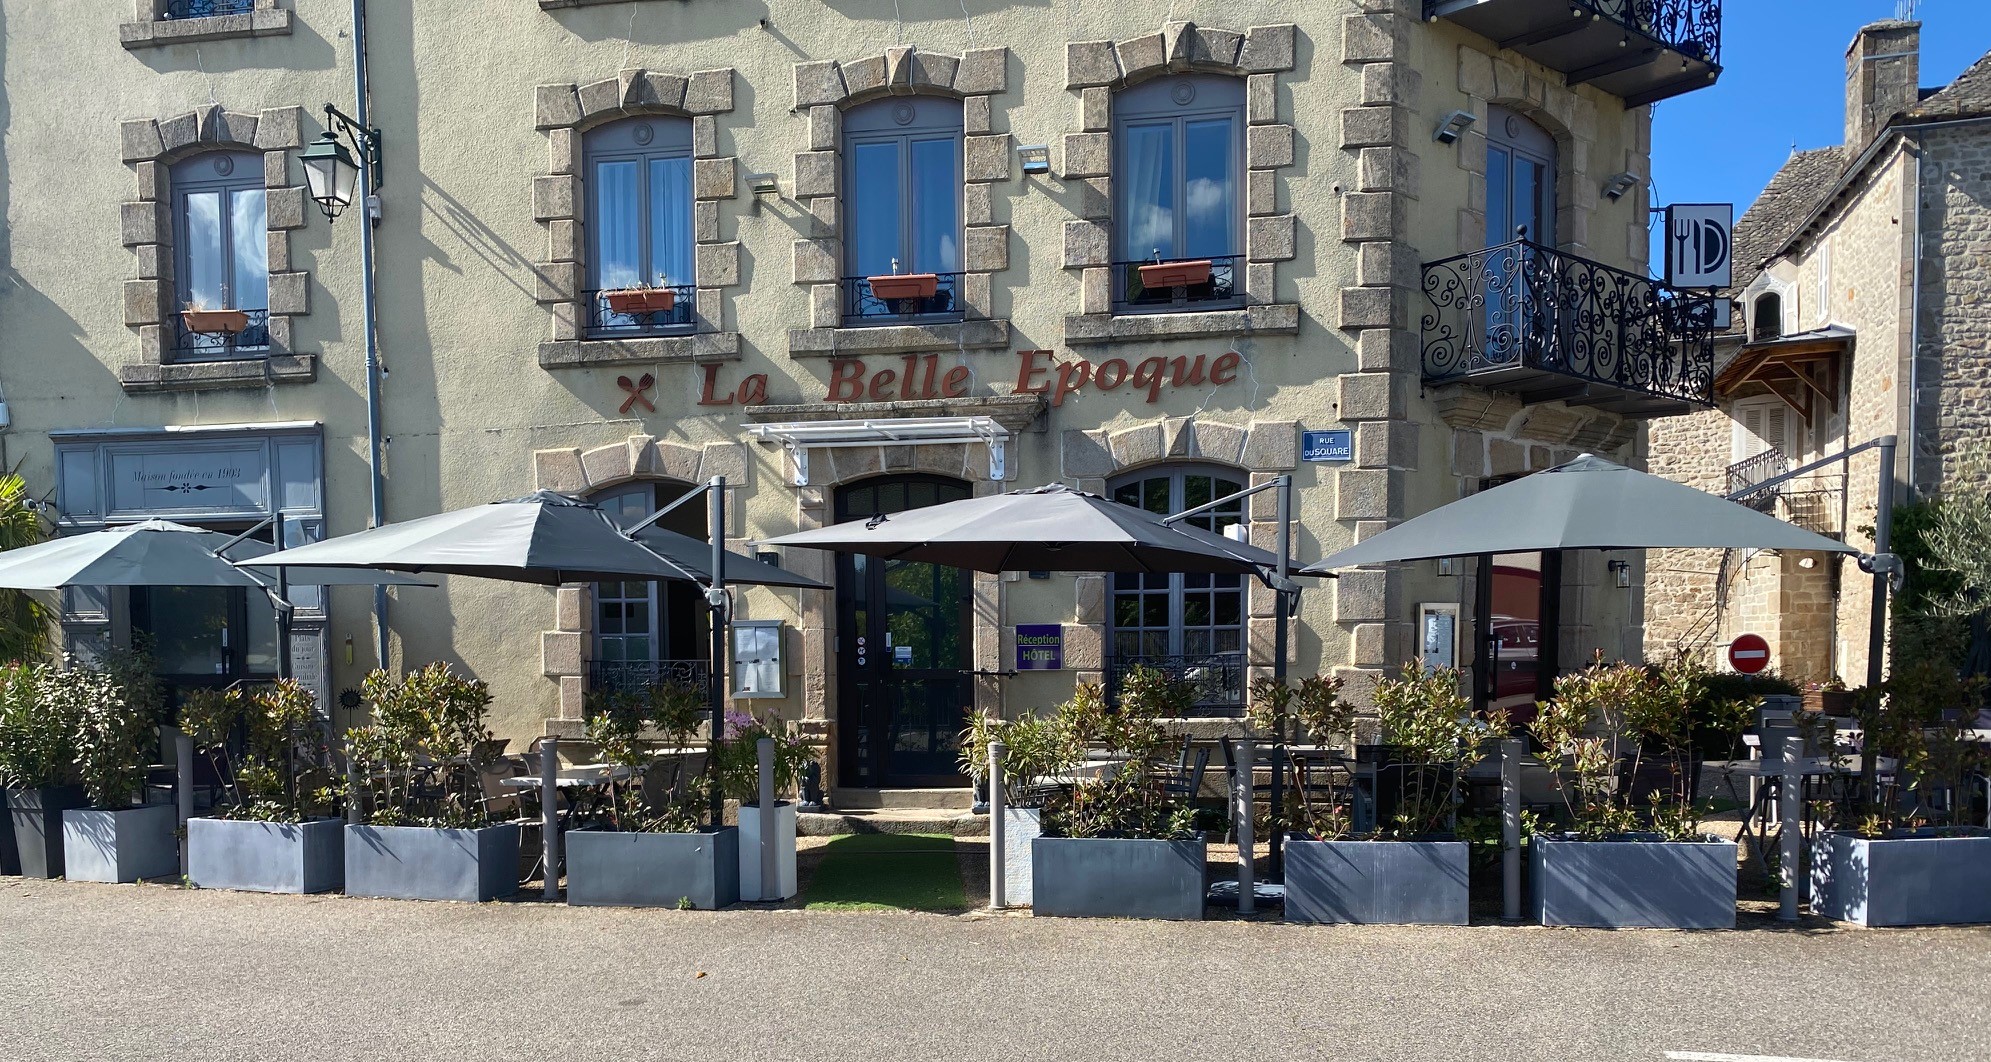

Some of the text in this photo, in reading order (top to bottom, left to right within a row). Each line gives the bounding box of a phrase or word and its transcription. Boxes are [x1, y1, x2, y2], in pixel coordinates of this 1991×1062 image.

[697, 350, 1240, 407] La Belle Epoque
[1314, 447, 1349, 456] SQUARE
[132, 468, 241, 483] Maison fondée en 1903
[1017, 634, 1060, 645] Réception
[1022, 648, 1056, 661] HÔTEL
